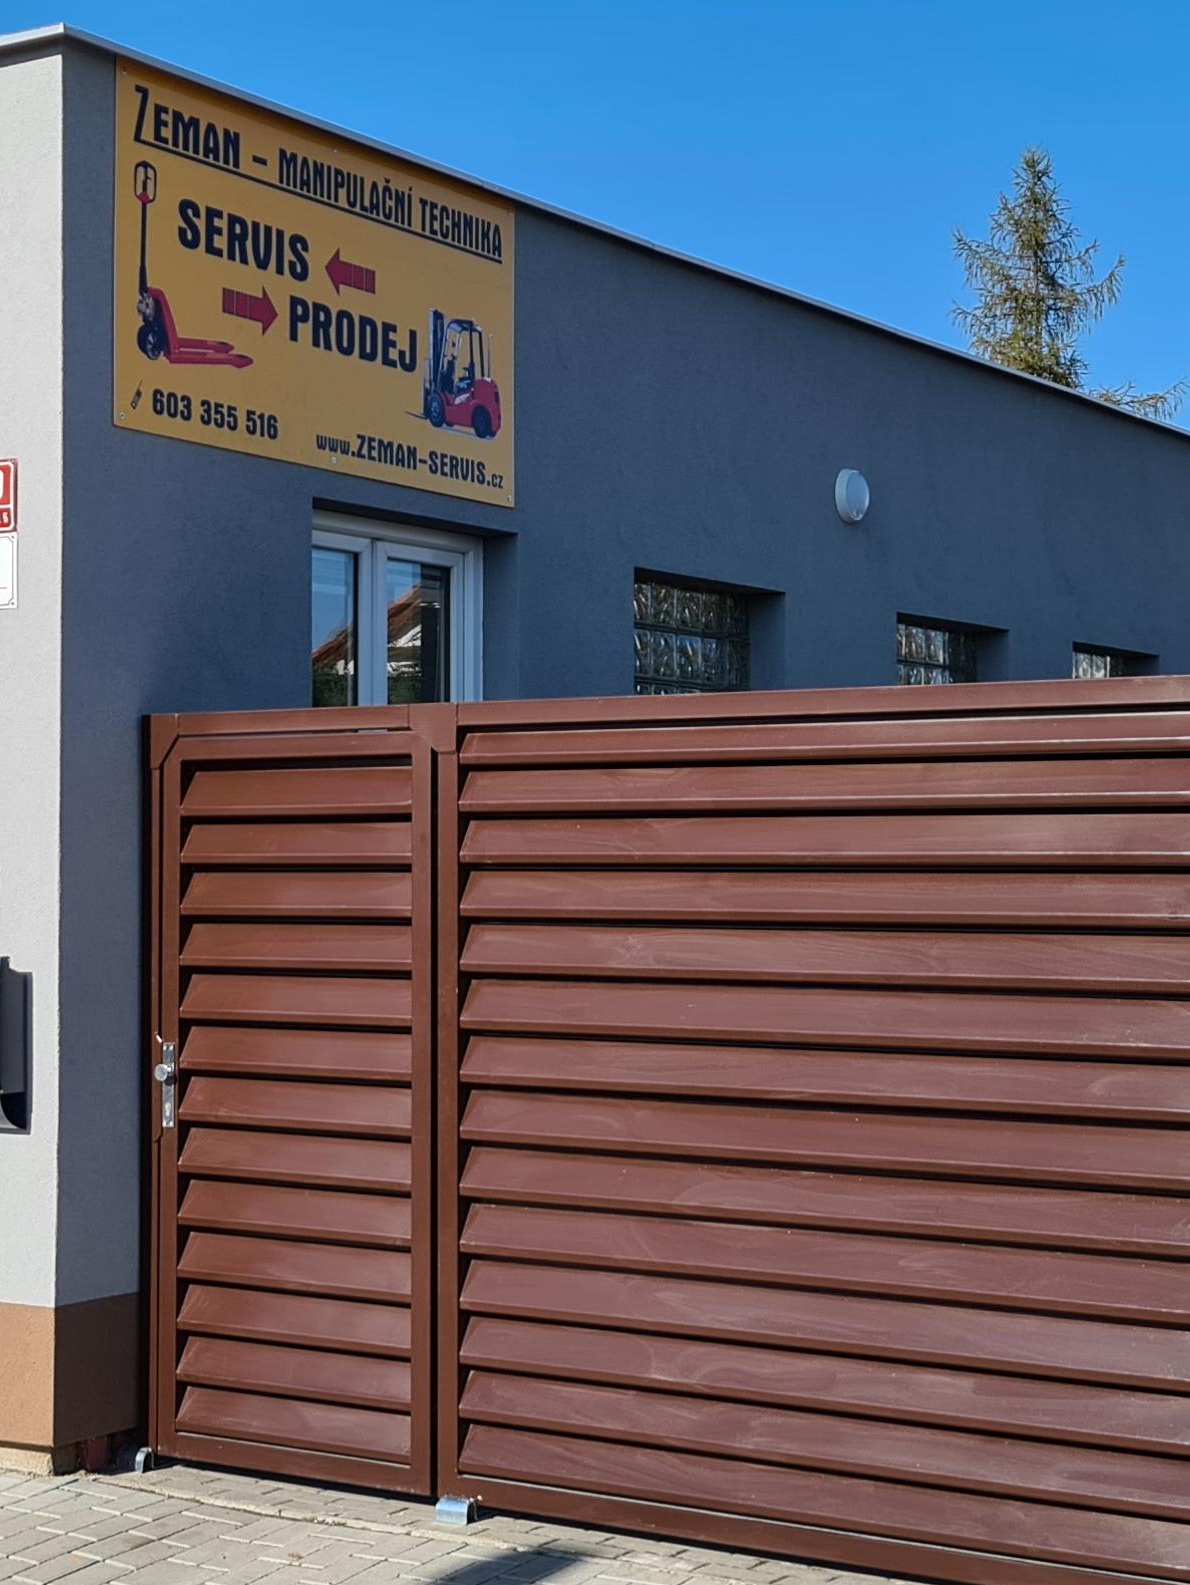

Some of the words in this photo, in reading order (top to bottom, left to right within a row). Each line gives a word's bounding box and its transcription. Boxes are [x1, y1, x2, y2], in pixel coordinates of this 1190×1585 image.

[134, 84, 241, 169] ZEMAN
[278, 147, 413, 228] MANIPULAČNÍ
[419, 200, 503, 259] TECHNIKA
[178, 198, 310, 282] SERVIS
[289, 294, 418, 374] PRODEJ
[152, 388, 192, 422] 603
[200, 401, 239, 431] 355
[245, 411, 279, 440] 516
[316, 433, 504, 490] www.ZEMAN-SERVIS.cz
